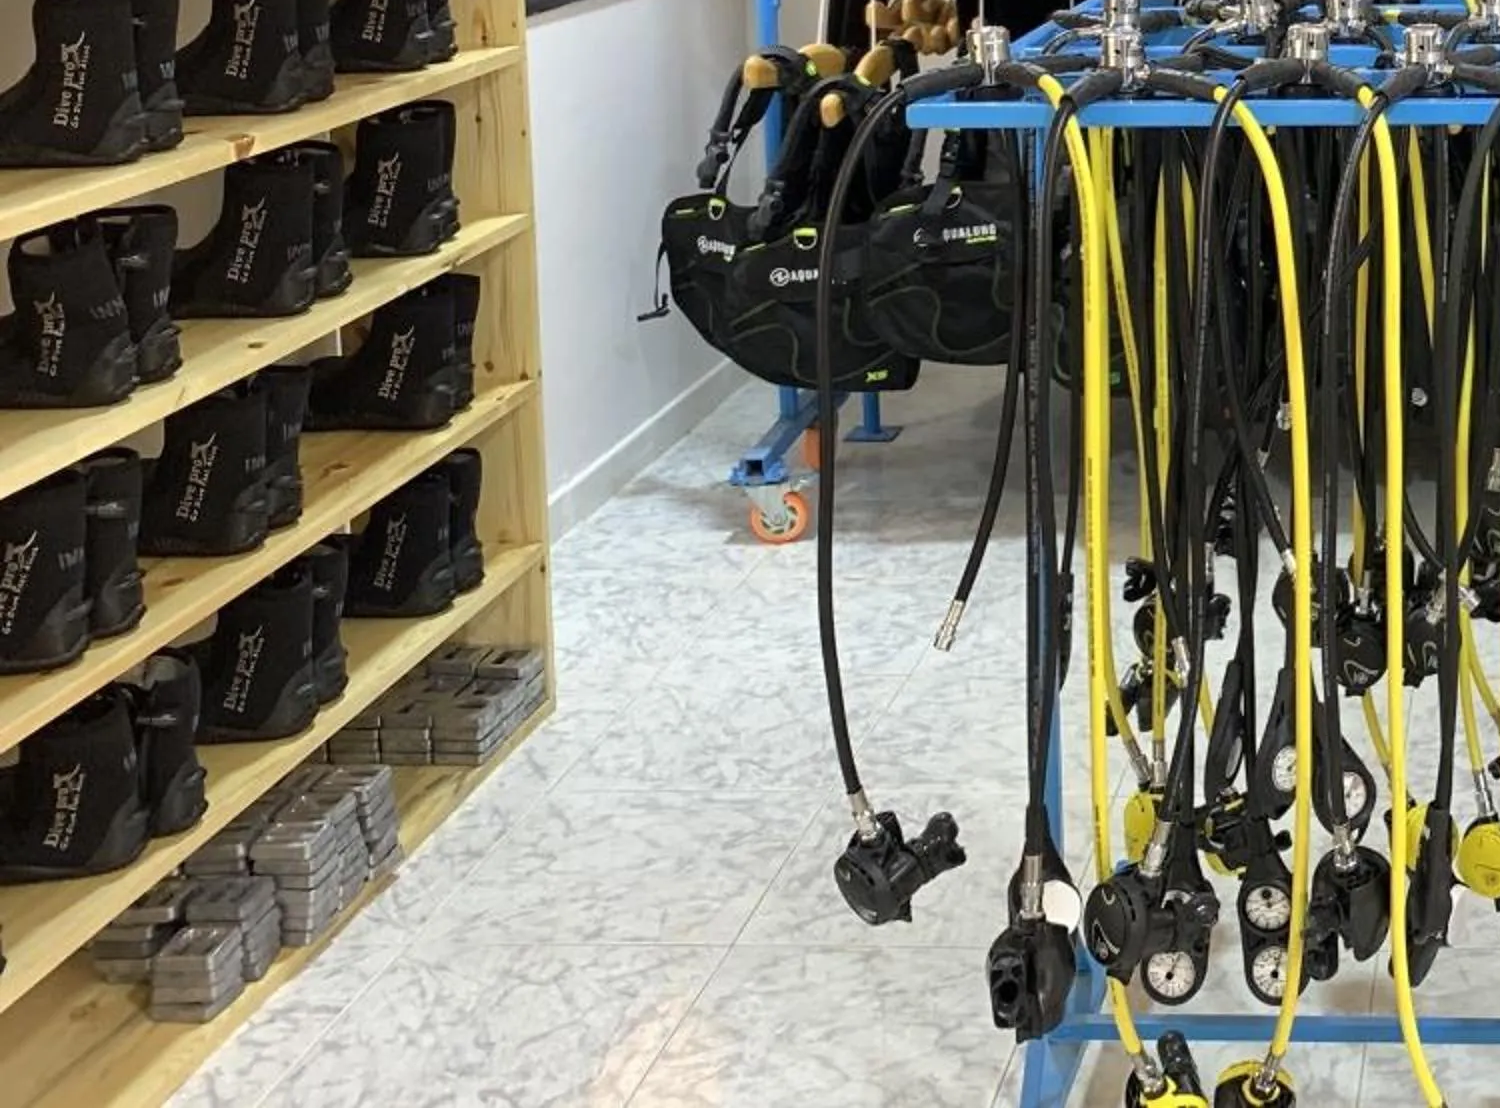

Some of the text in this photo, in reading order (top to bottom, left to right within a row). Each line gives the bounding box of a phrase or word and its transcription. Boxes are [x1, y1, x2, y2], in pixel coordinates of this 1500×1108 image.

[53, 61, 84, 127] Dive pro
[942, 223, 997, 242] QUALUNG
